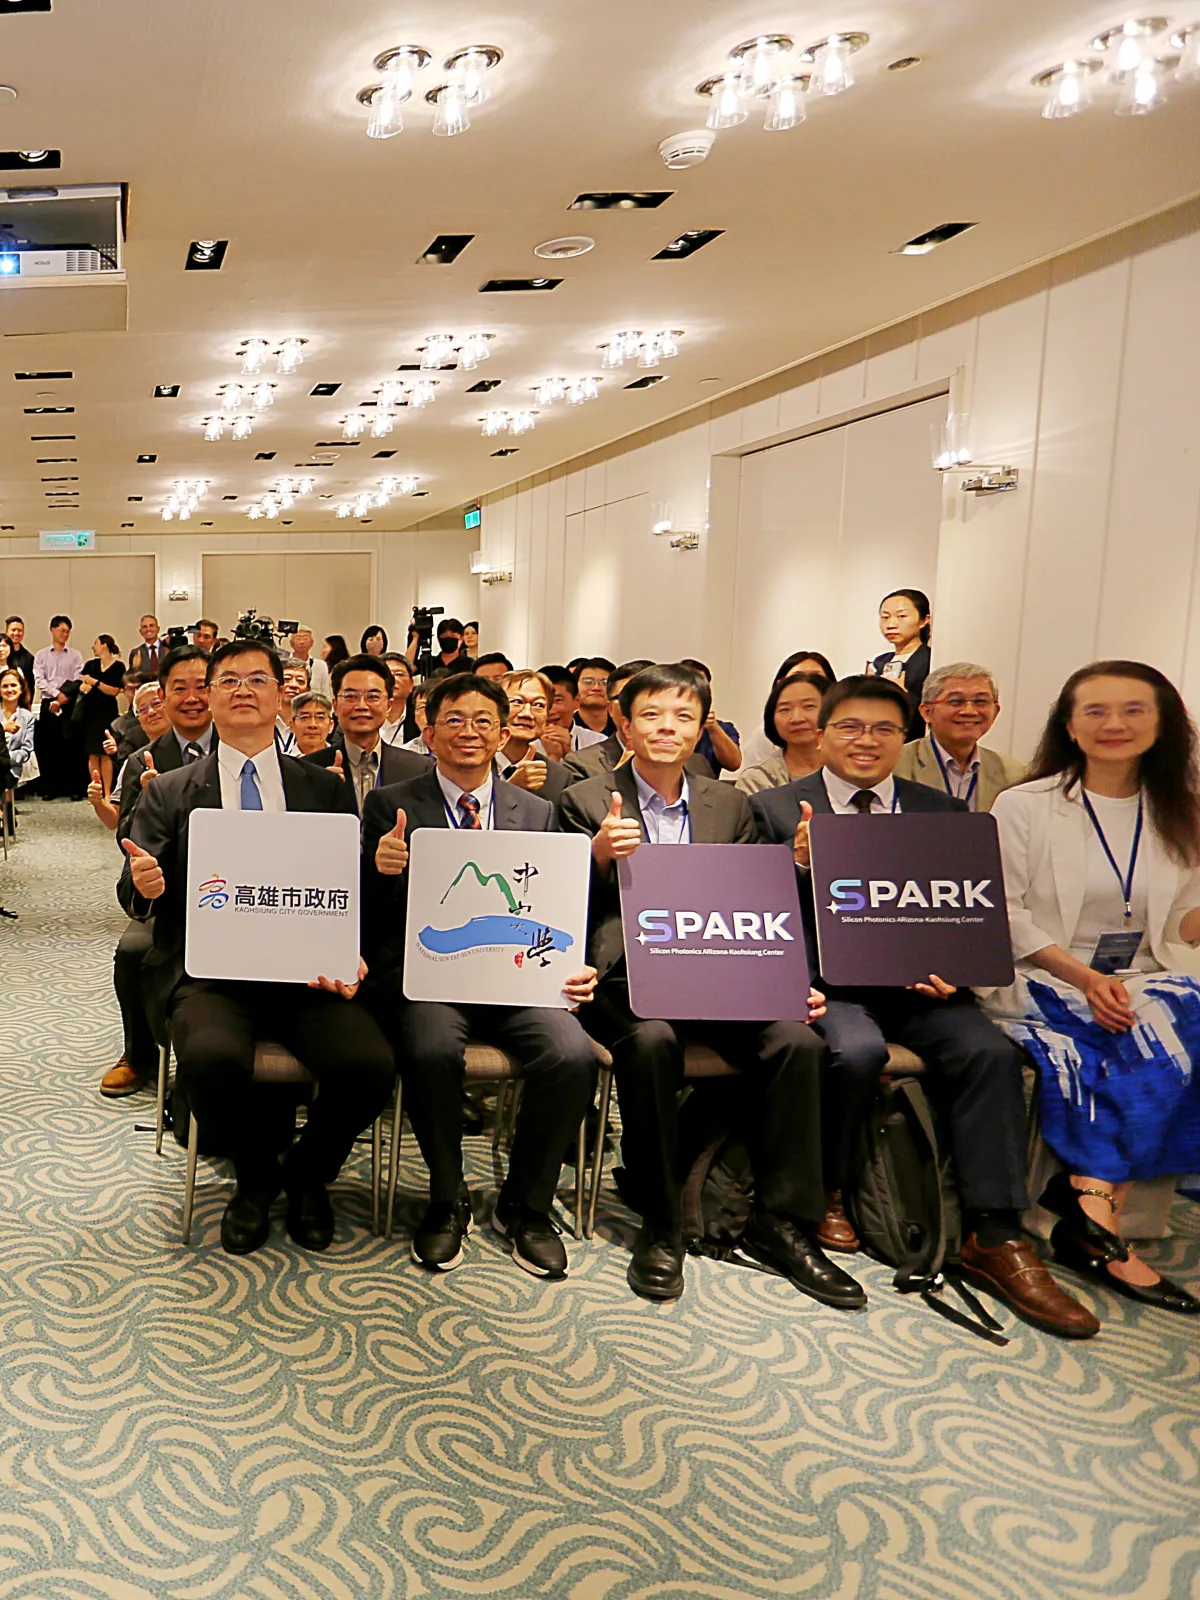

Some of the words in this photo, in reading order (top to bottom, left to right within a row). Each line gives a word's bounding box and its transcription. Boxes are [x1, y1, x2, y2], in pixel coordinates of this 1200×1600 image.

[235, 885, 349, 910] 高雄市政府
[829, 879, 994, 911] SPARK
[235, 907, 277, 915] KAOHSIUNG
[297, 909, 349, 917] GOVERNMENT
[638, 909, 794, 942] SPARK
[416, 941, 438, 962] NATIONAL
[471, 946, 504, 955] UNIVERSITY
